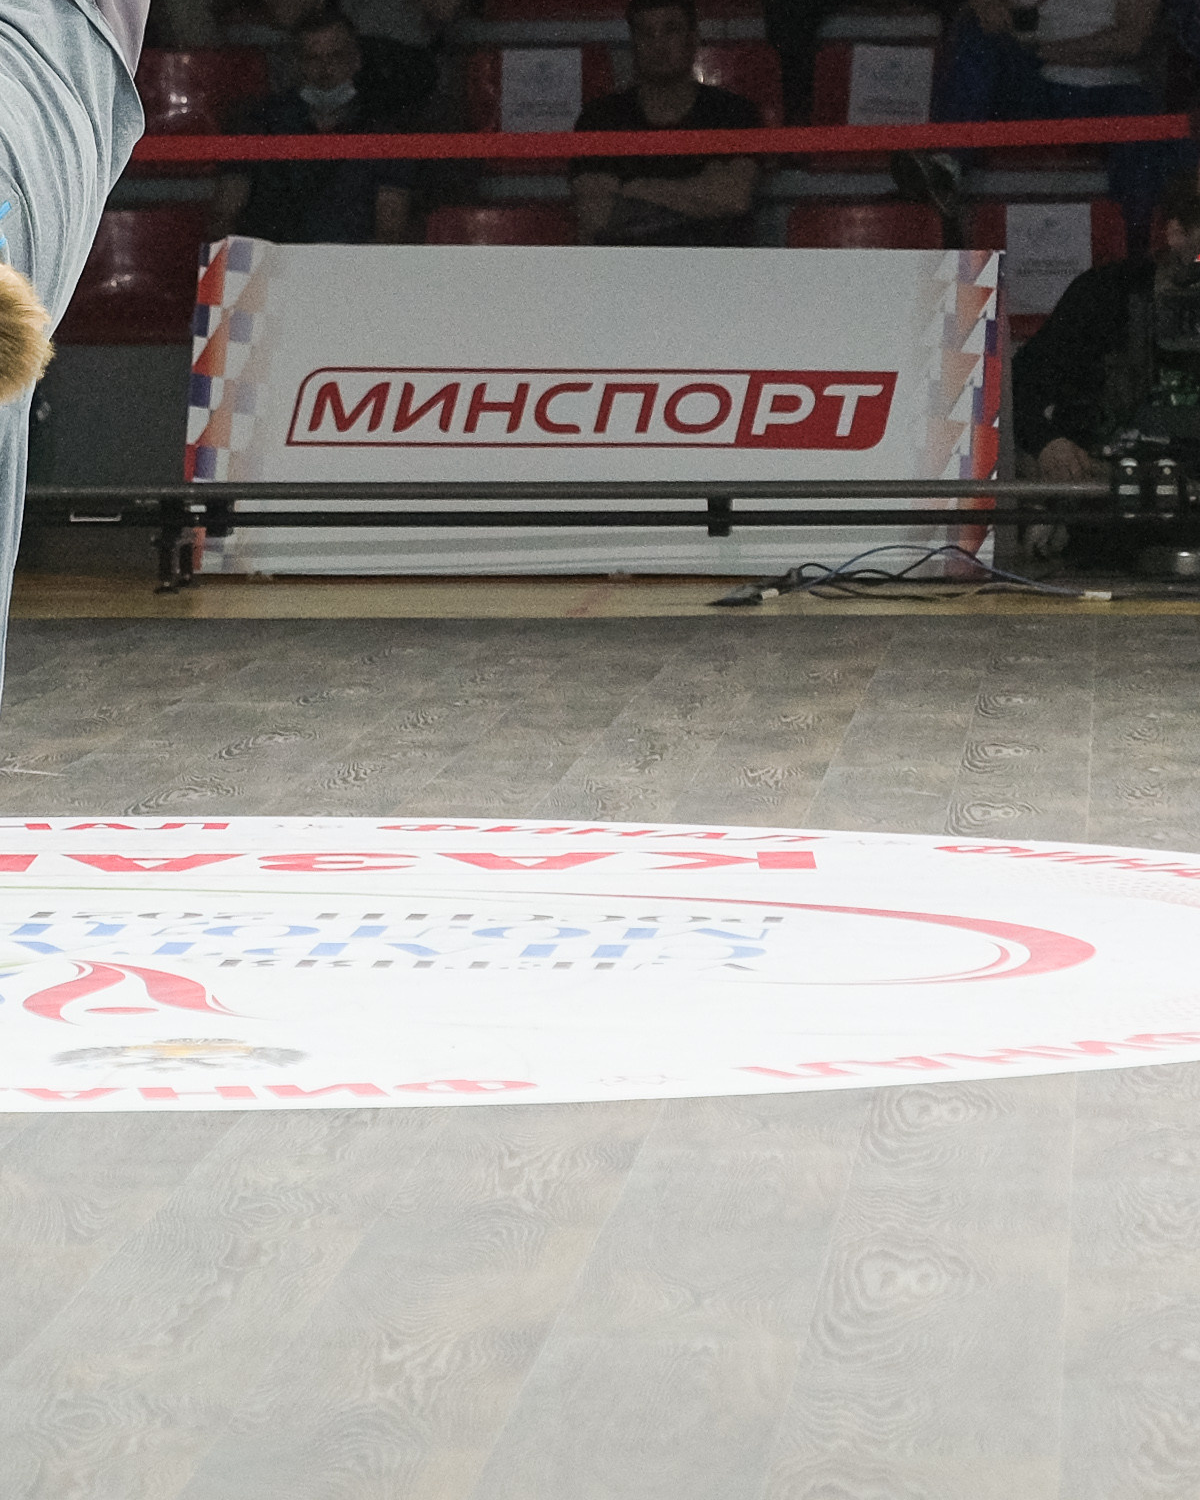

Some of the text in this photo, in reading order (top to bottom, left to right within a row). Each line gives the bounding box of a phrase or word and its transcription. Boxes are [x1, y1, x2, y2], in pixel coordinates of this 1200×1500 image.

[308, 381, 885, 437] МИНСПОРТ
[377, 823, 828, 843] ФИНАЛ
[25, 910, 277, 921] 2021
